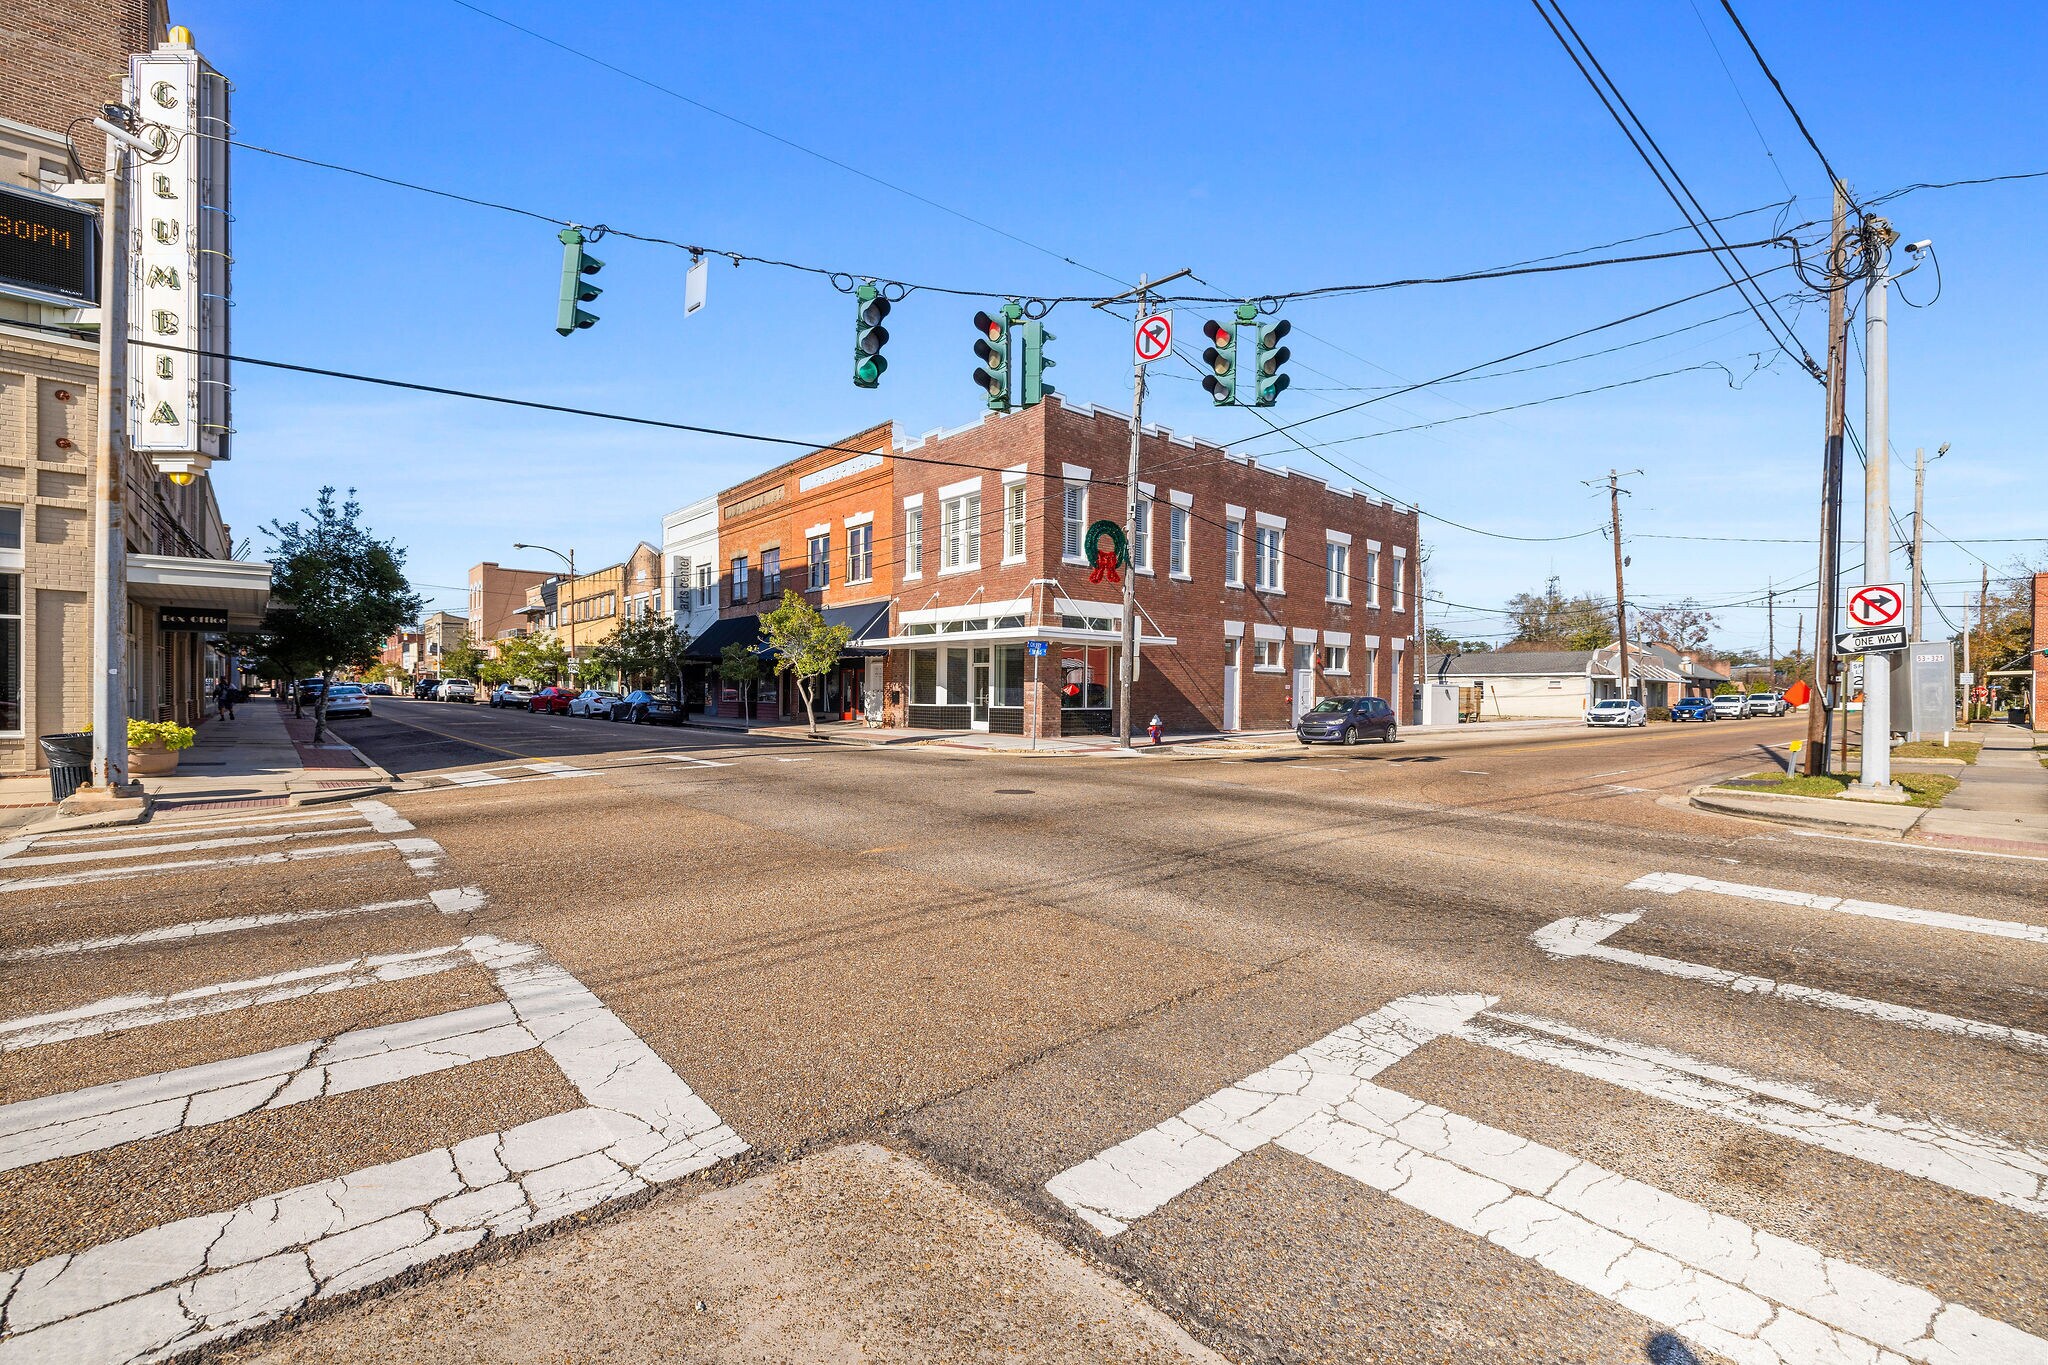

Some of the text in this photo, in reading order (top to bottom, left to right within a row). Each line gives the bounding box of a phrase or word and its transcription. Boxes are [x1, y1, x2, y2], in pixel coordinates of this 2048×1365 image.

[146, 80, 181, 426] COLUMBIA
[677, 556, 690, 610] arts center
[162, 615, 185, 623] Box
[1854, 633, 1899, 647] ONE WAY
